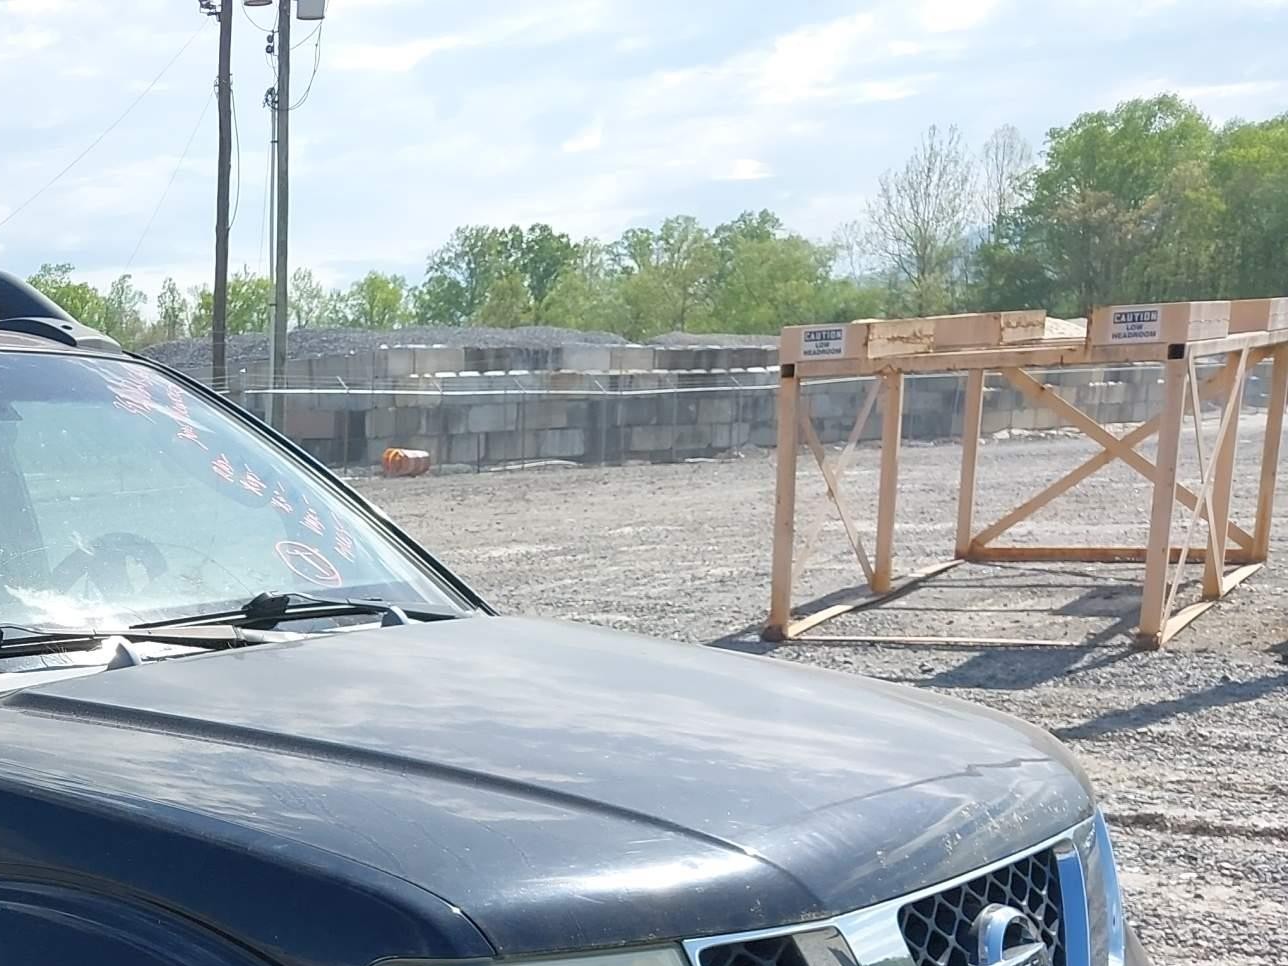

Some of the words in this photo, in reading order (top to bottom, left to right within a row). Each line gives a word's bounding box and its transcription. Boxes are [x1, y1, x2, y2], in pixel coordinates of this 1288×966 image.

[1114, 312, 1158, 323] CAUTION
[804, 330, 842, 341] CAUTION
[1112, 331, 1157, 340] HEADROOM
